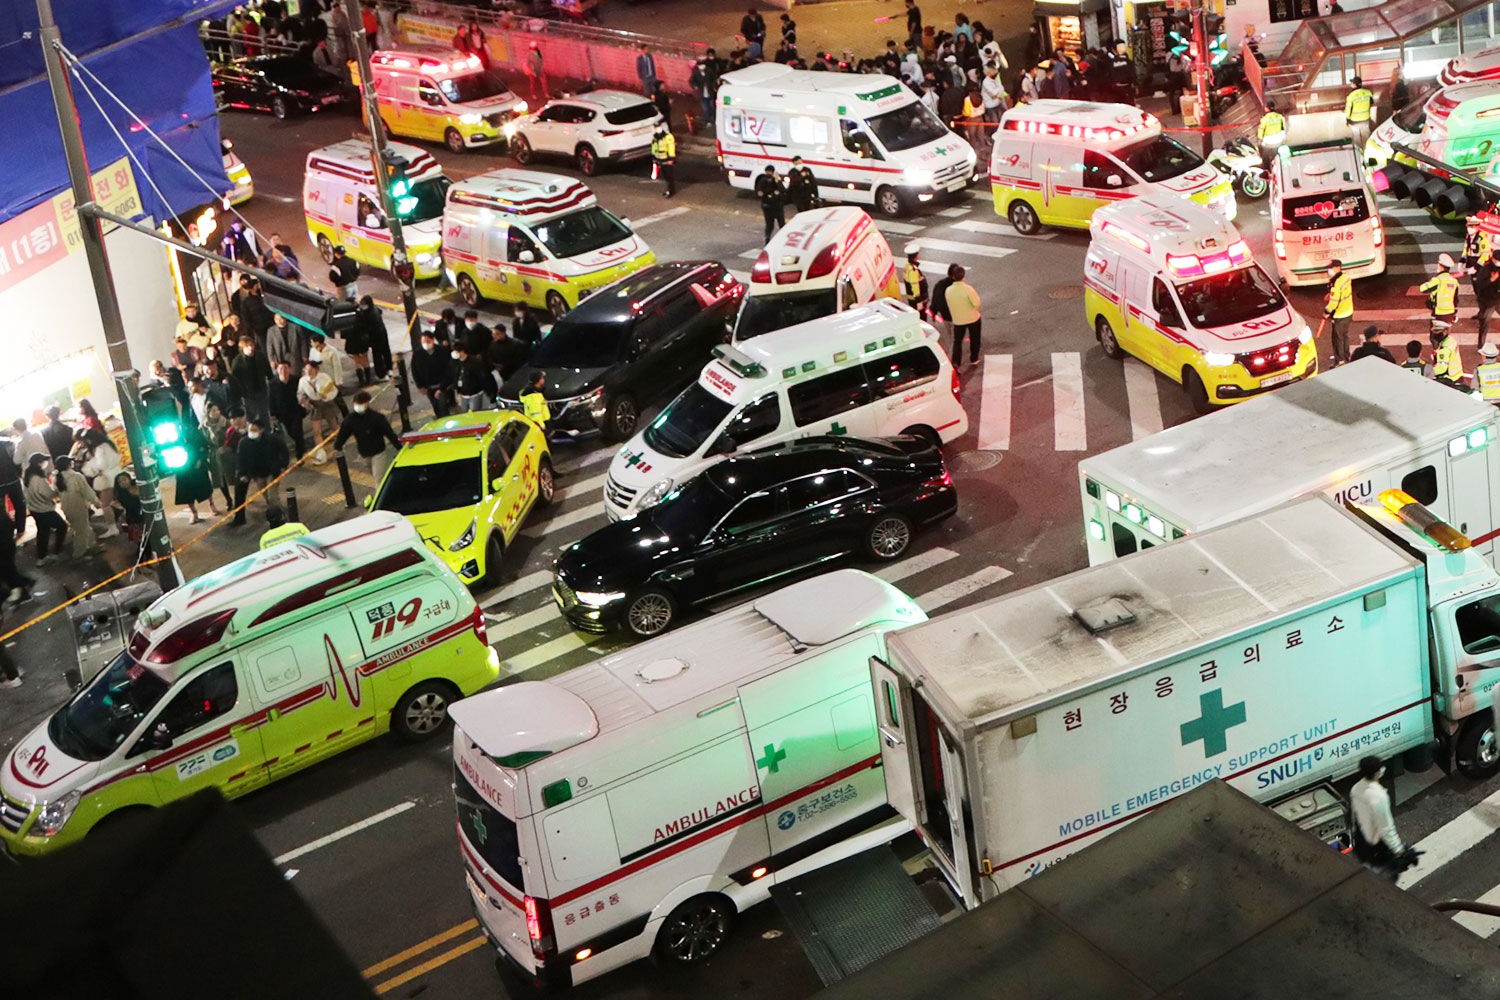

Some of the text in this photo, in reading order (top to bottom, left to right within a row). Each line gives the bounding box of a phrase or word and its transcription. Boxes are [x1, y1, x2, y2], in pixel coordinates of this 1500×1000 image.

[372, 597, 423, 641] 119
[423, 599, 451, 619] 구급대
[376, 637, 429, 666] AMBULANCE
[1329, 721, 1402, 759] 서울대학교병원
[459, 755, 504, 808] AMBULANCE
[1058, 718, 1338, 838] MOBILE EMERGENCY SUPPORT UNIT
[1257, 755, 1313, 789] SNUH
[652, 783, 761, 844] AMBULANCE
